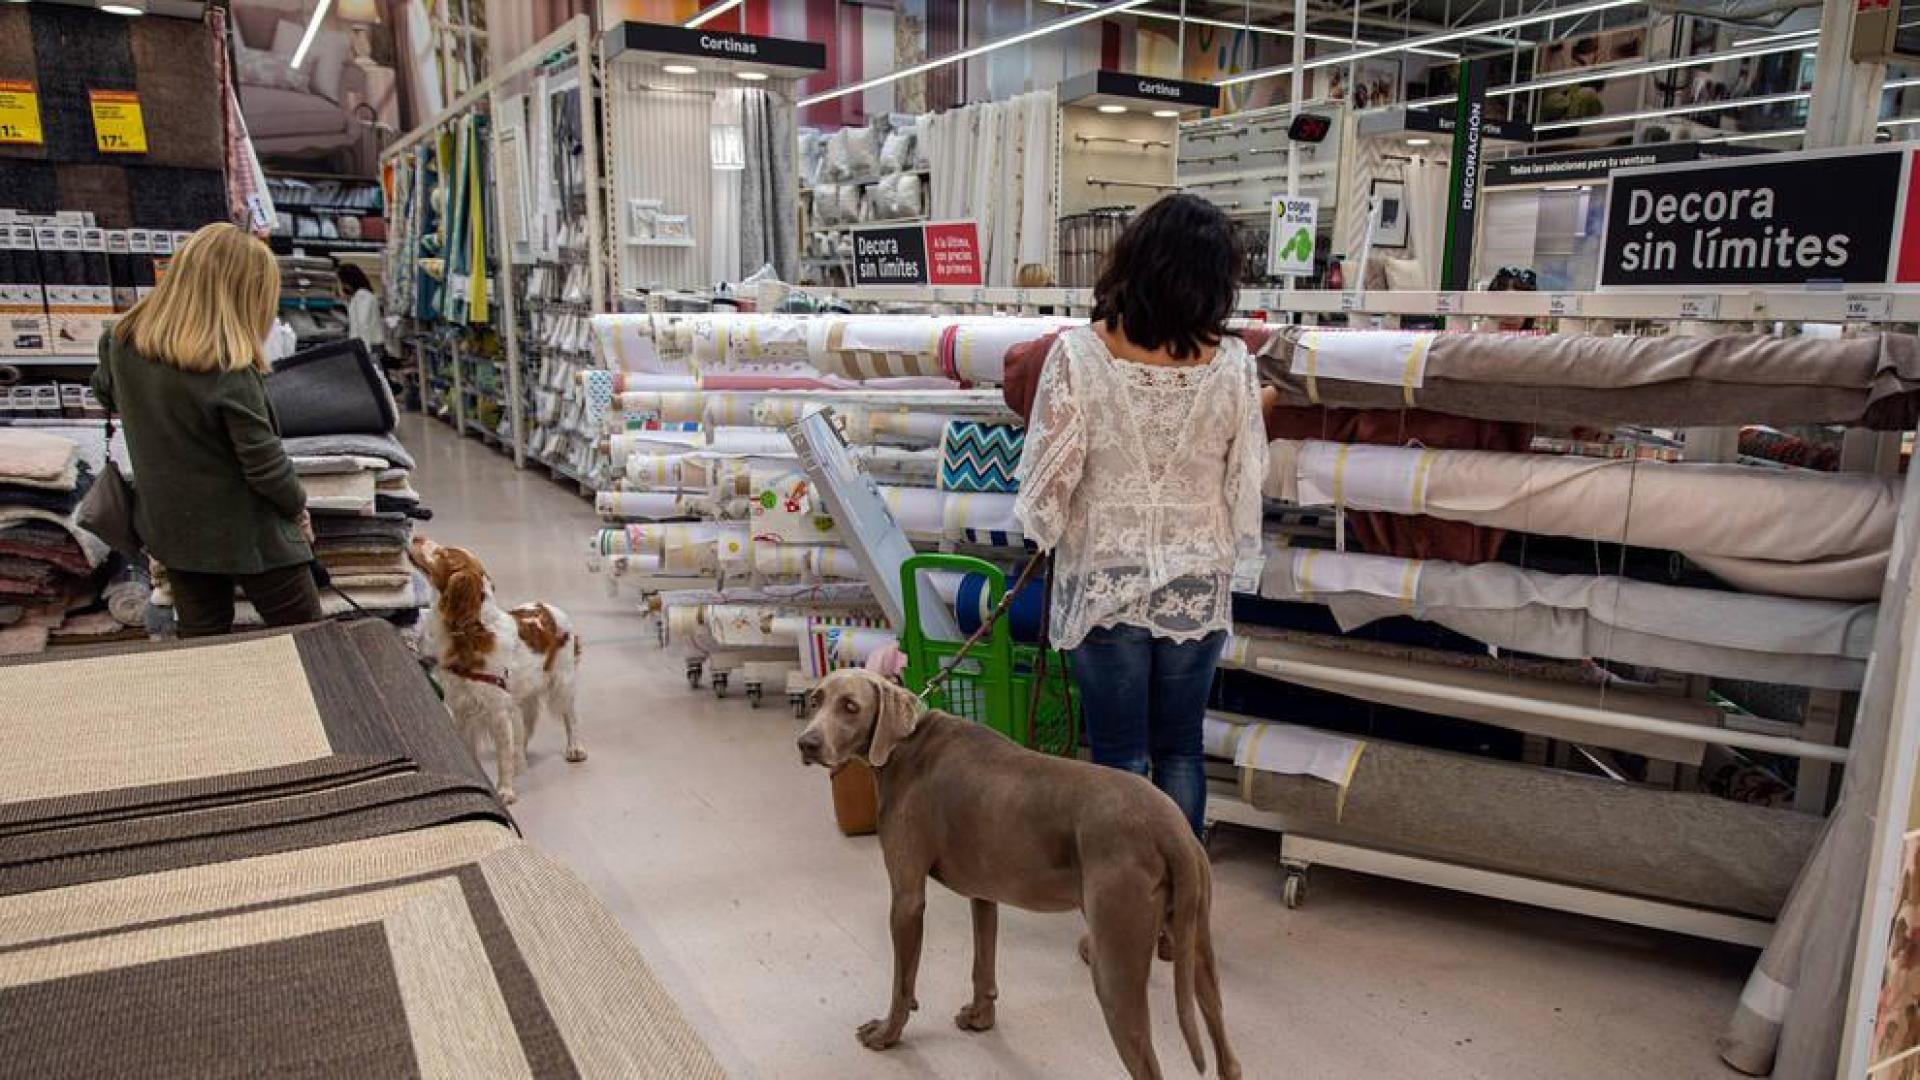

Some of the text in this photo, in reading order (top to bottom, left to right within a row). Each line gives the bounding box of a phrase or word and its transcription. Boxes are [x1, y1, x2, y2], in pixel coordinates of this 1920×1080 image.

[700, 35, 757, 54] Cortinas
[1138, 81, 1180, 97] Cortinas
[1461, 102, 1481, 210] DECORACIÓN
[1628, 187, 1775, 226] Decora
[858, 237, 899, 255] Decora
[1620, 226, 1850, 271] sin límites
[860, 256, 920, 278] sin límites
